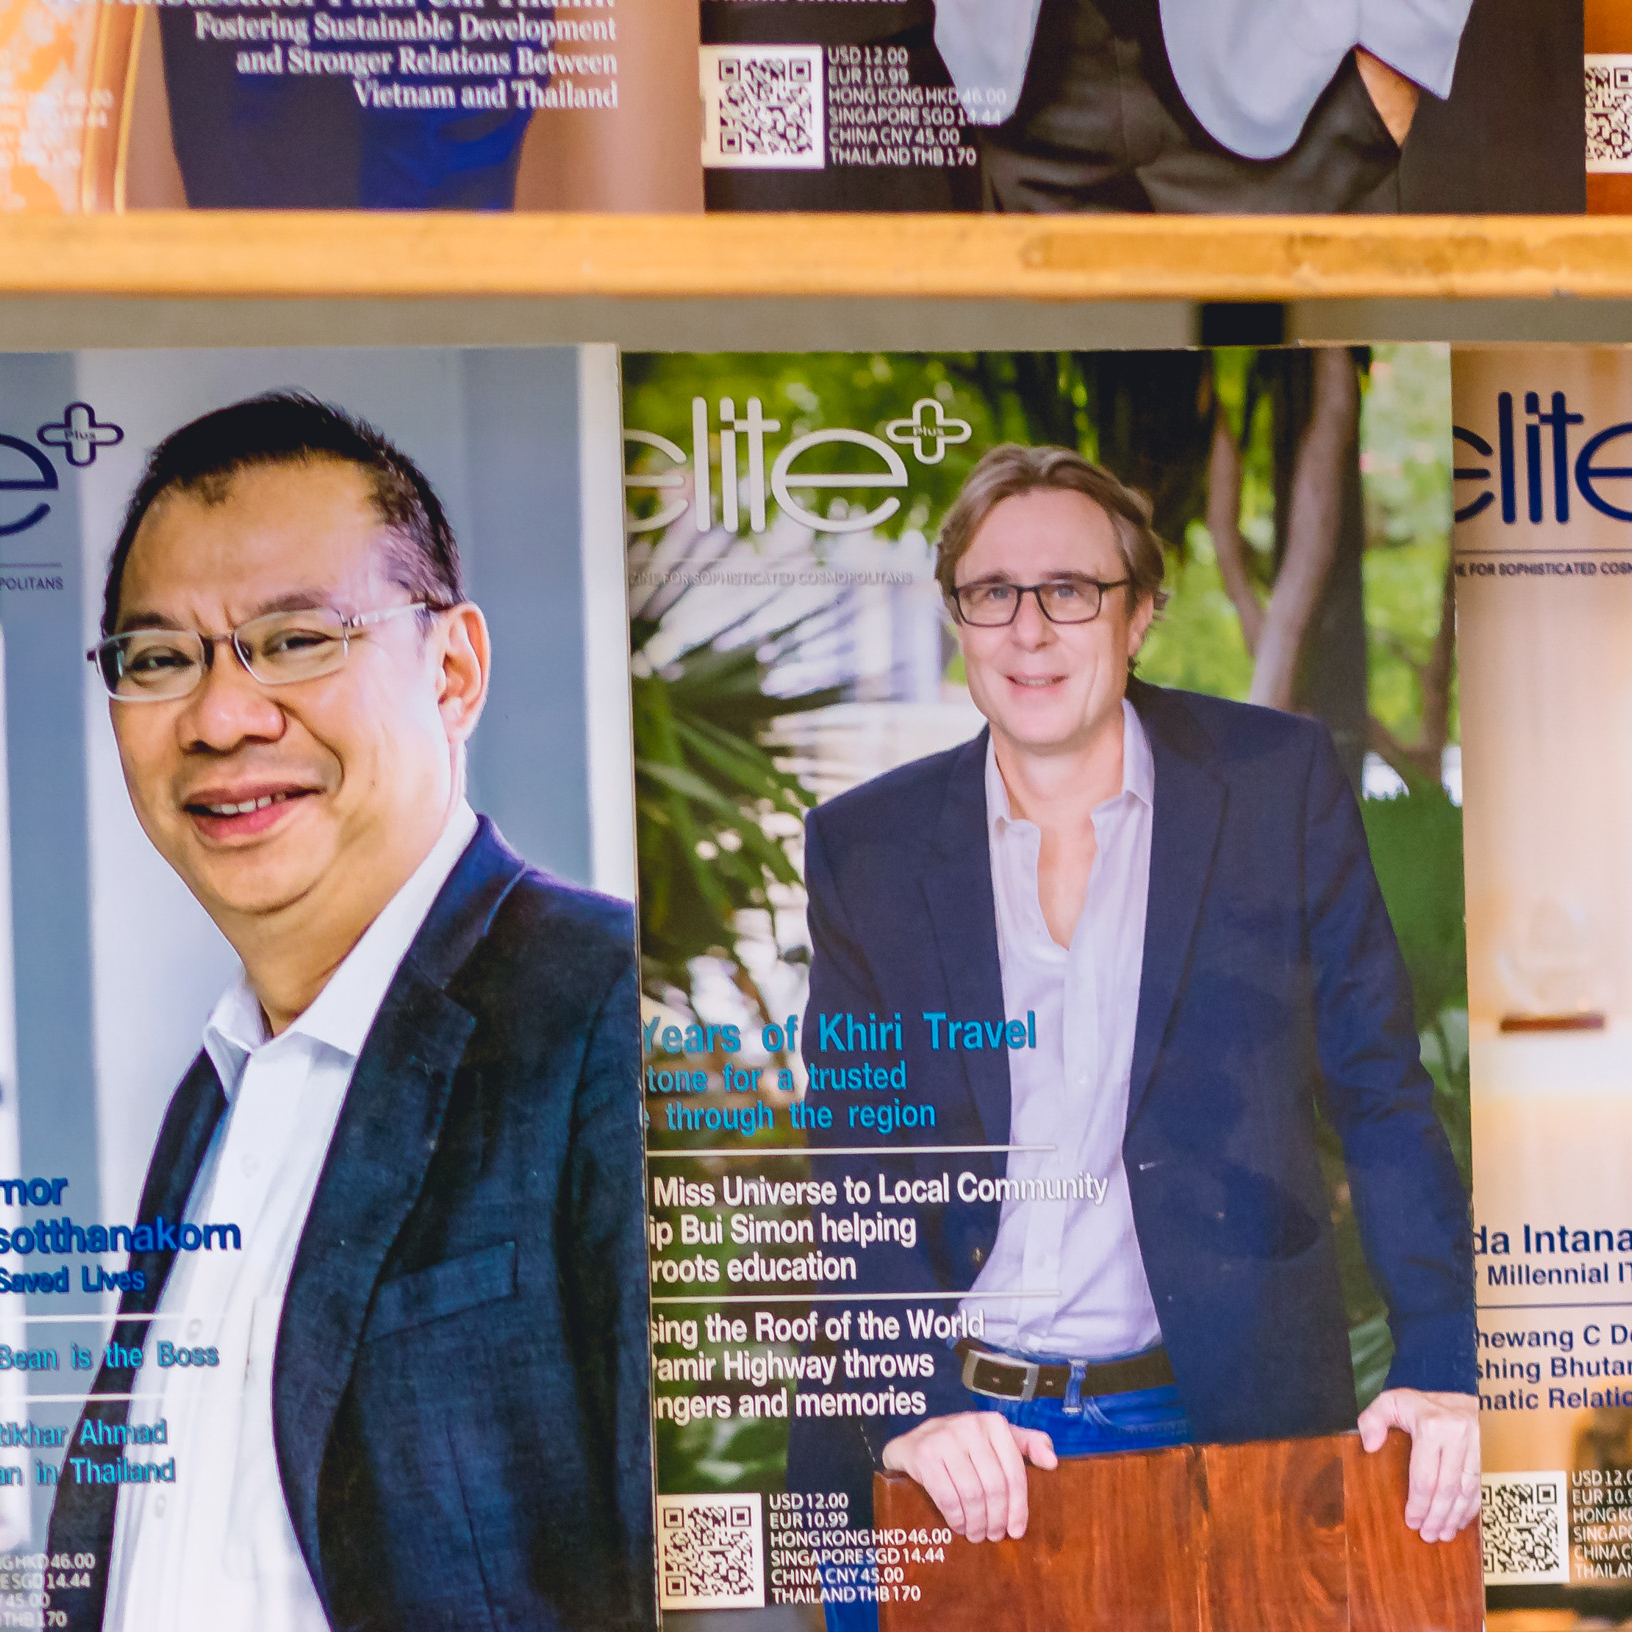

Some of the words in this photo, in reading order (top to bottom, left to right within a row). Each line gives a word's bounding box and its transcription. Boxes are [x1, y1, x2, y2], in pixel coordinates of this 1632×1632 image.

[195, 13, 310, 46] Fostering
[314, 12, 453, 41] Sustainable
[459, 13, 617, 47] Development
[236, 45, 282, 74] and
[287, 46, 393, 79] Stronger
[398, 46, 511, 74] Relations
[517, 47, 618, 74] Between
[353, 80, 456, 107] Vietnam
[461, 80, 507, 108] and
[511, 81, 618, 108] Thailand
[643, 1017, 741, 1054] Years
[762, 1016, 798, 1052] of
[819, 1012, 903, 1052] Khiri
[923, 1010, 1036, 1050] Travel
[722, 1063, 762, 1093] for
[777, 1069, 794, 1092] a
[809, 1061, 907, 1092] trusted
[666, 1101, 775, 1137] through
[789, 1100, 833, 1129] the
[848, 1098, 936, 1135] region
[654, 1175, 715, 1207] Miss
[722, 1175, 837, 1206] Universe
[843, 1175, 871, 1204] to
[879, 1172, 950, 1204] Local
[957, 1170, 1110, 1205] Community
[681, 1214, 723, 1246] Bui
[730, 1213, 813, 1243] Simon
[821, 1213, 917, 1248] helping
[82, 1265, 146, 1293] Lives
[727, 1253, 857, 1282] education
[1488, 1263, 1609, 1286] Millennial
[705, 1313, 747, 1343] the
[754, 1310, 818, 1342] Roof
[825, 1310, 852, 1340] of
[858, 1310, 900, 1340] the
[906, 1307, 985, 1340] World
[1583, 1324, 1601, 1347] C
[72, 1343, 91, 1369] is
[106, 1343, 143, 1369] the
[157, 1341, 219, 1367] Boss
[723, 1350, 837, 1387] Highway
[843, 1349, 935, 1379] throws
[738, 1389, 788, 1419] and
[795, 1386, 927, 1417] memories
